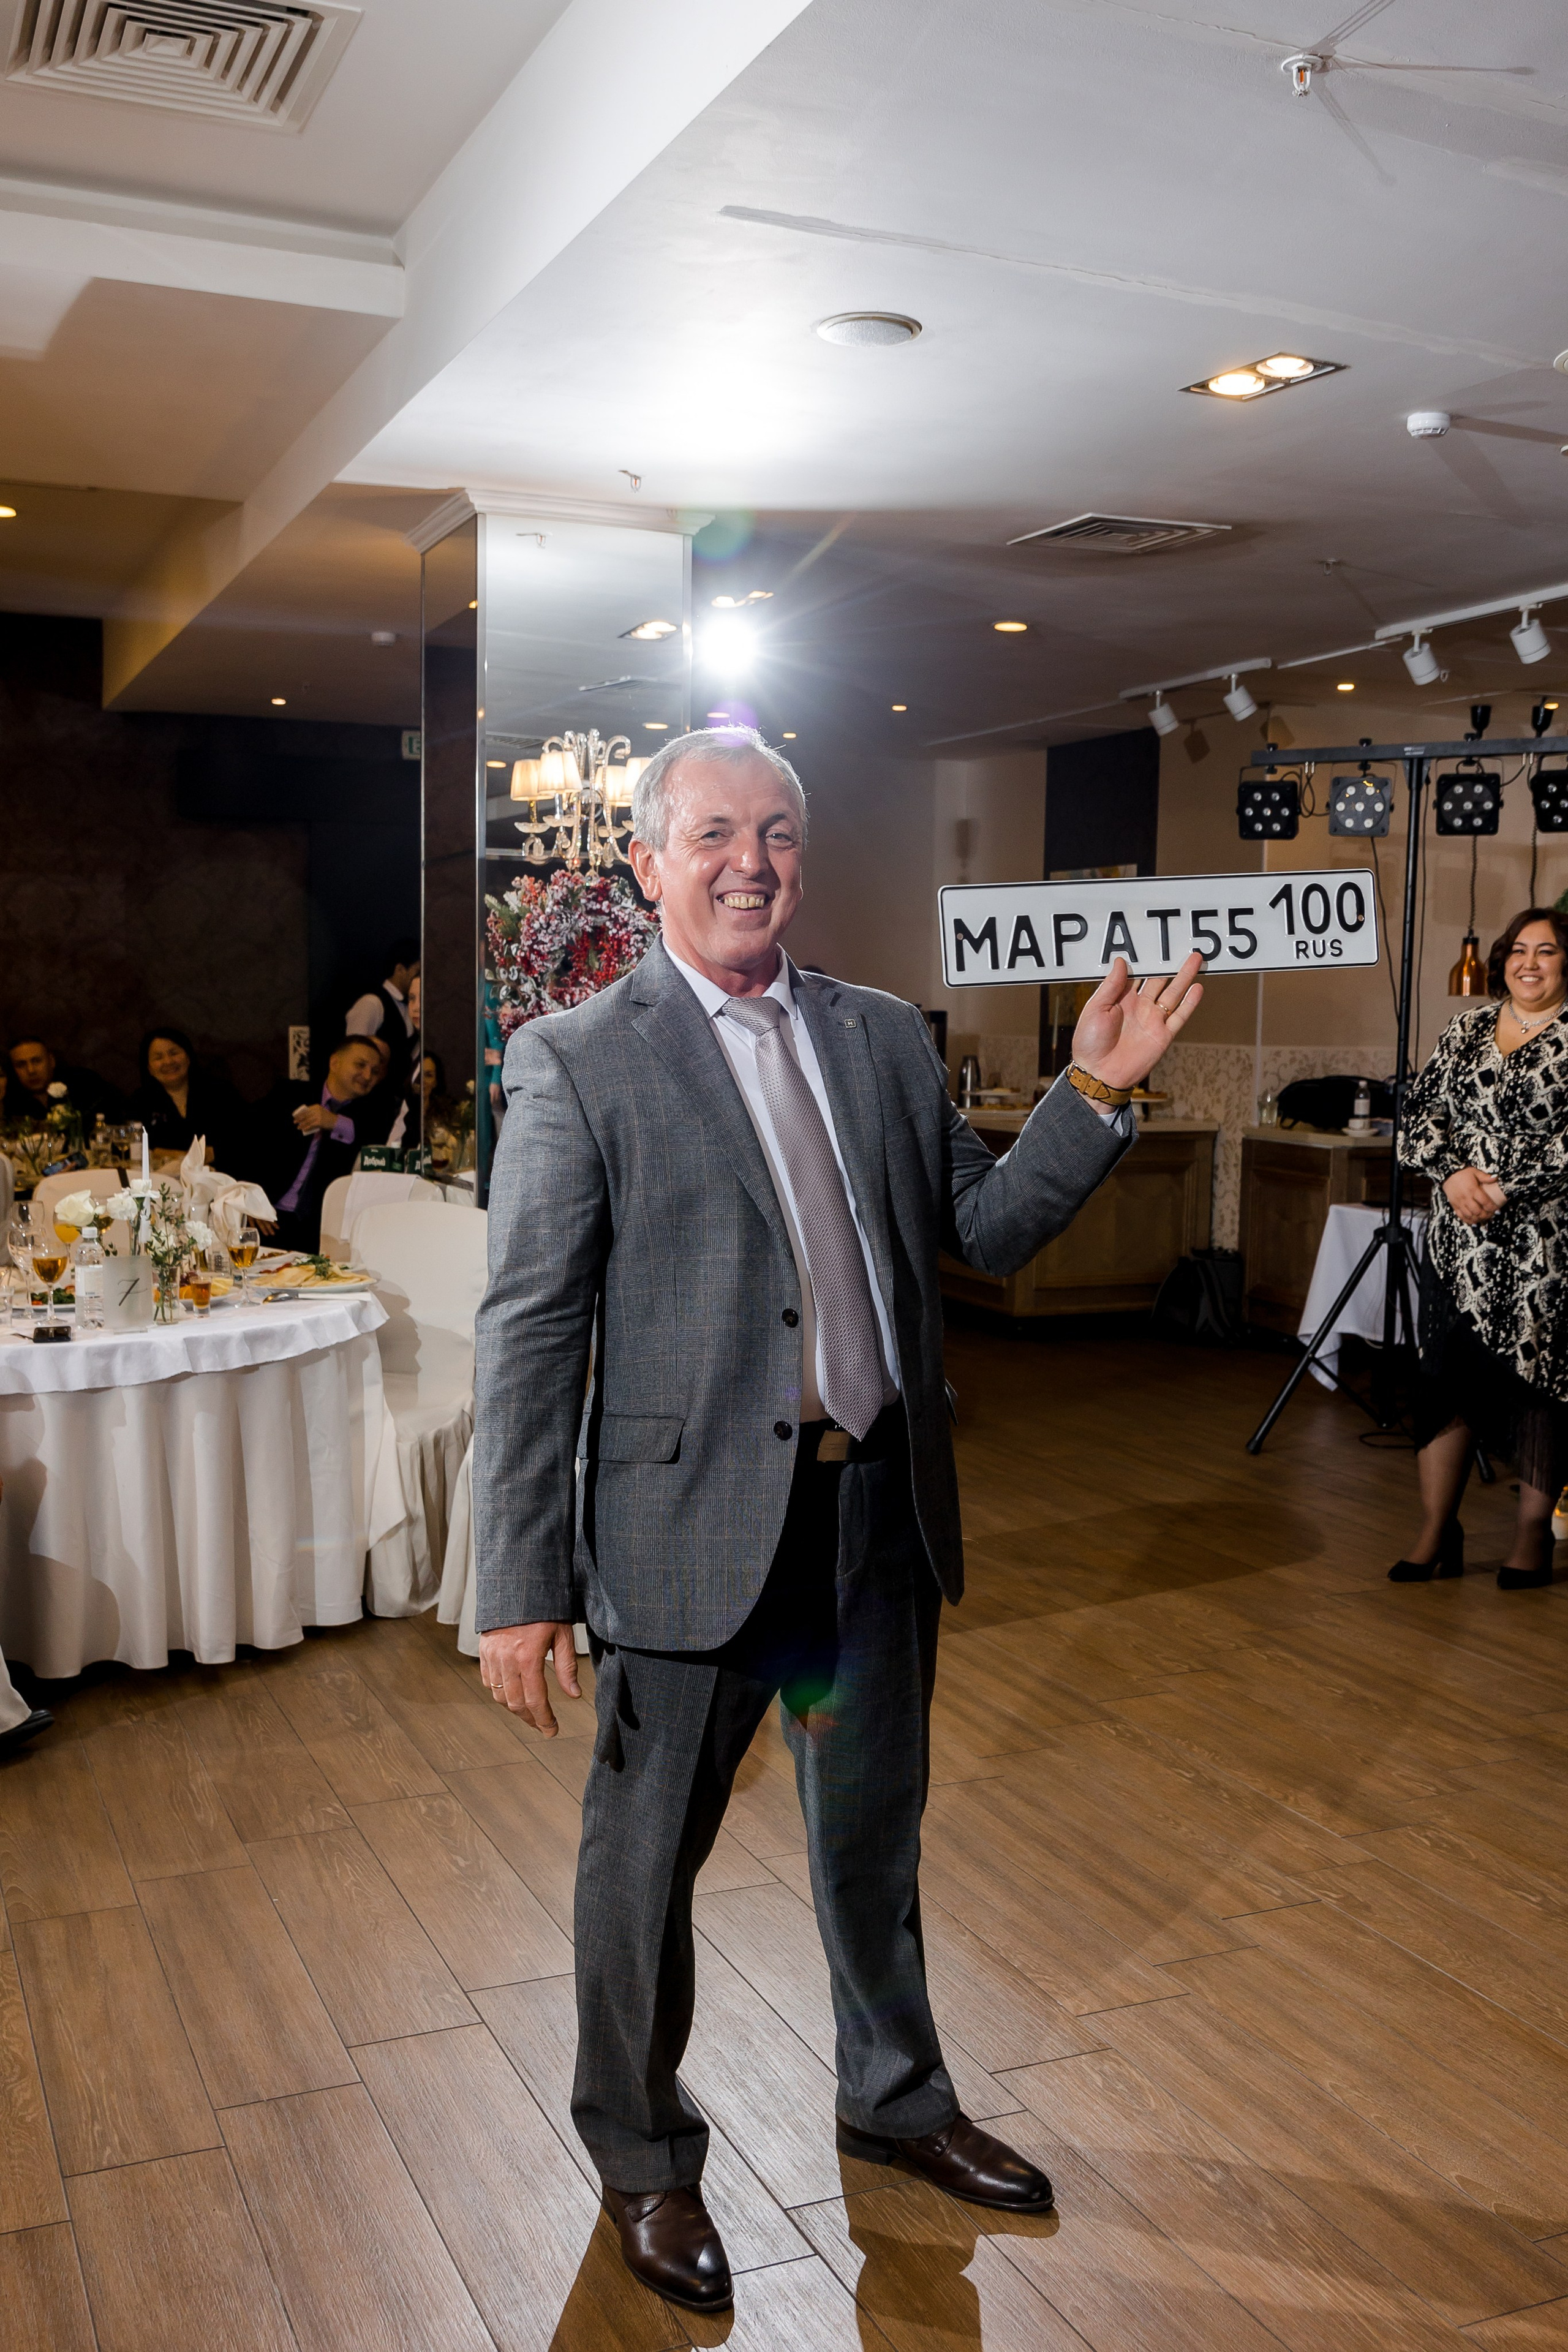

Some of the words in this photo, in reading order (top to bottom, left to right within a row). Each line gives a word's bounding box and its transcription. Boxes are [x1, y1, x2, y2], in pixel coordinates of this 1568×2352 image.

[1268, 881, 1365, 935] 100
[1295, 938, 1343, 959] RUS
[118, 1278, 148, 1306] 7
